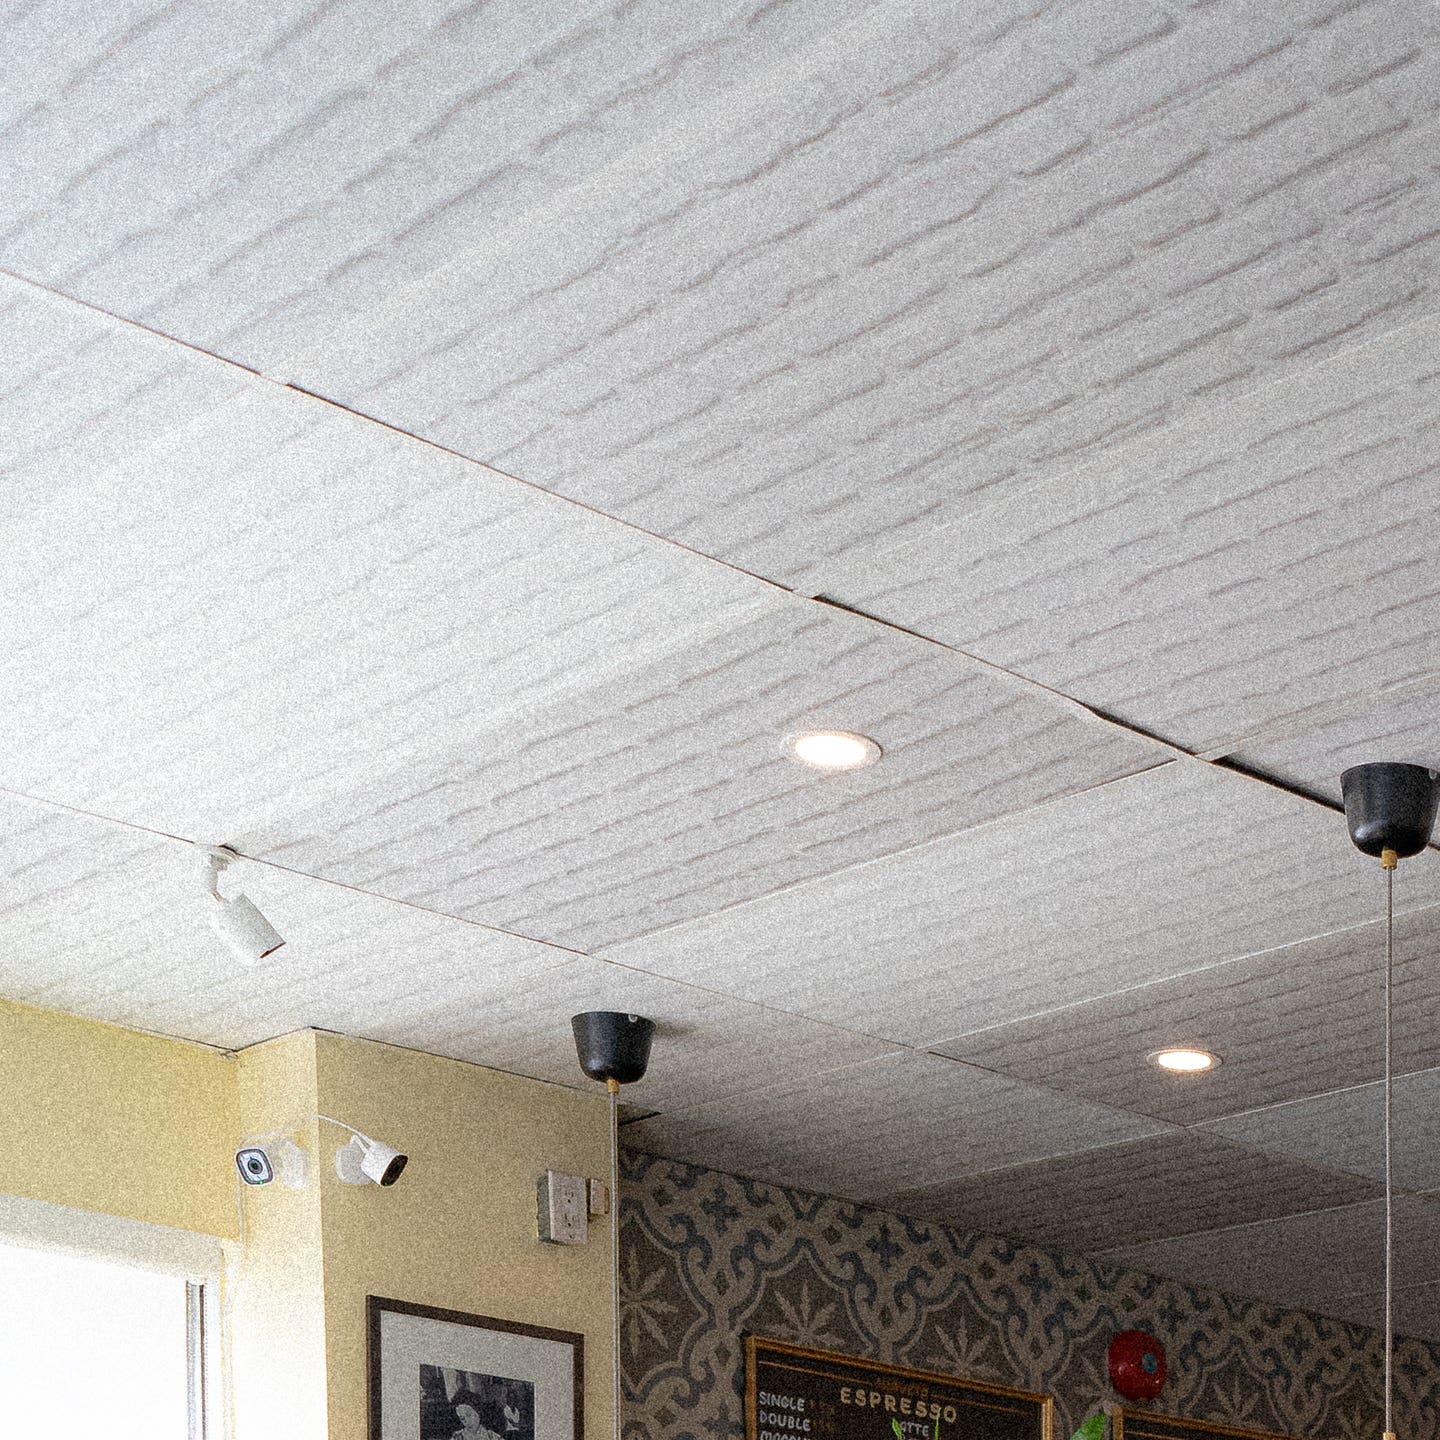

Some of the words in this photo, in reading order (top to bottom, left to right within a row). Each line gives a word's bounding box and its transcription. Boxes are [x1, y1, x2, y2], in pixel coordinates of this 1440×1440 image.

[759, 1391, 805, 1412] SINGLE
[840, 1386, 957, 1423] ESPRESSO
[759, 1410, 811, 1432] DOUBLE
